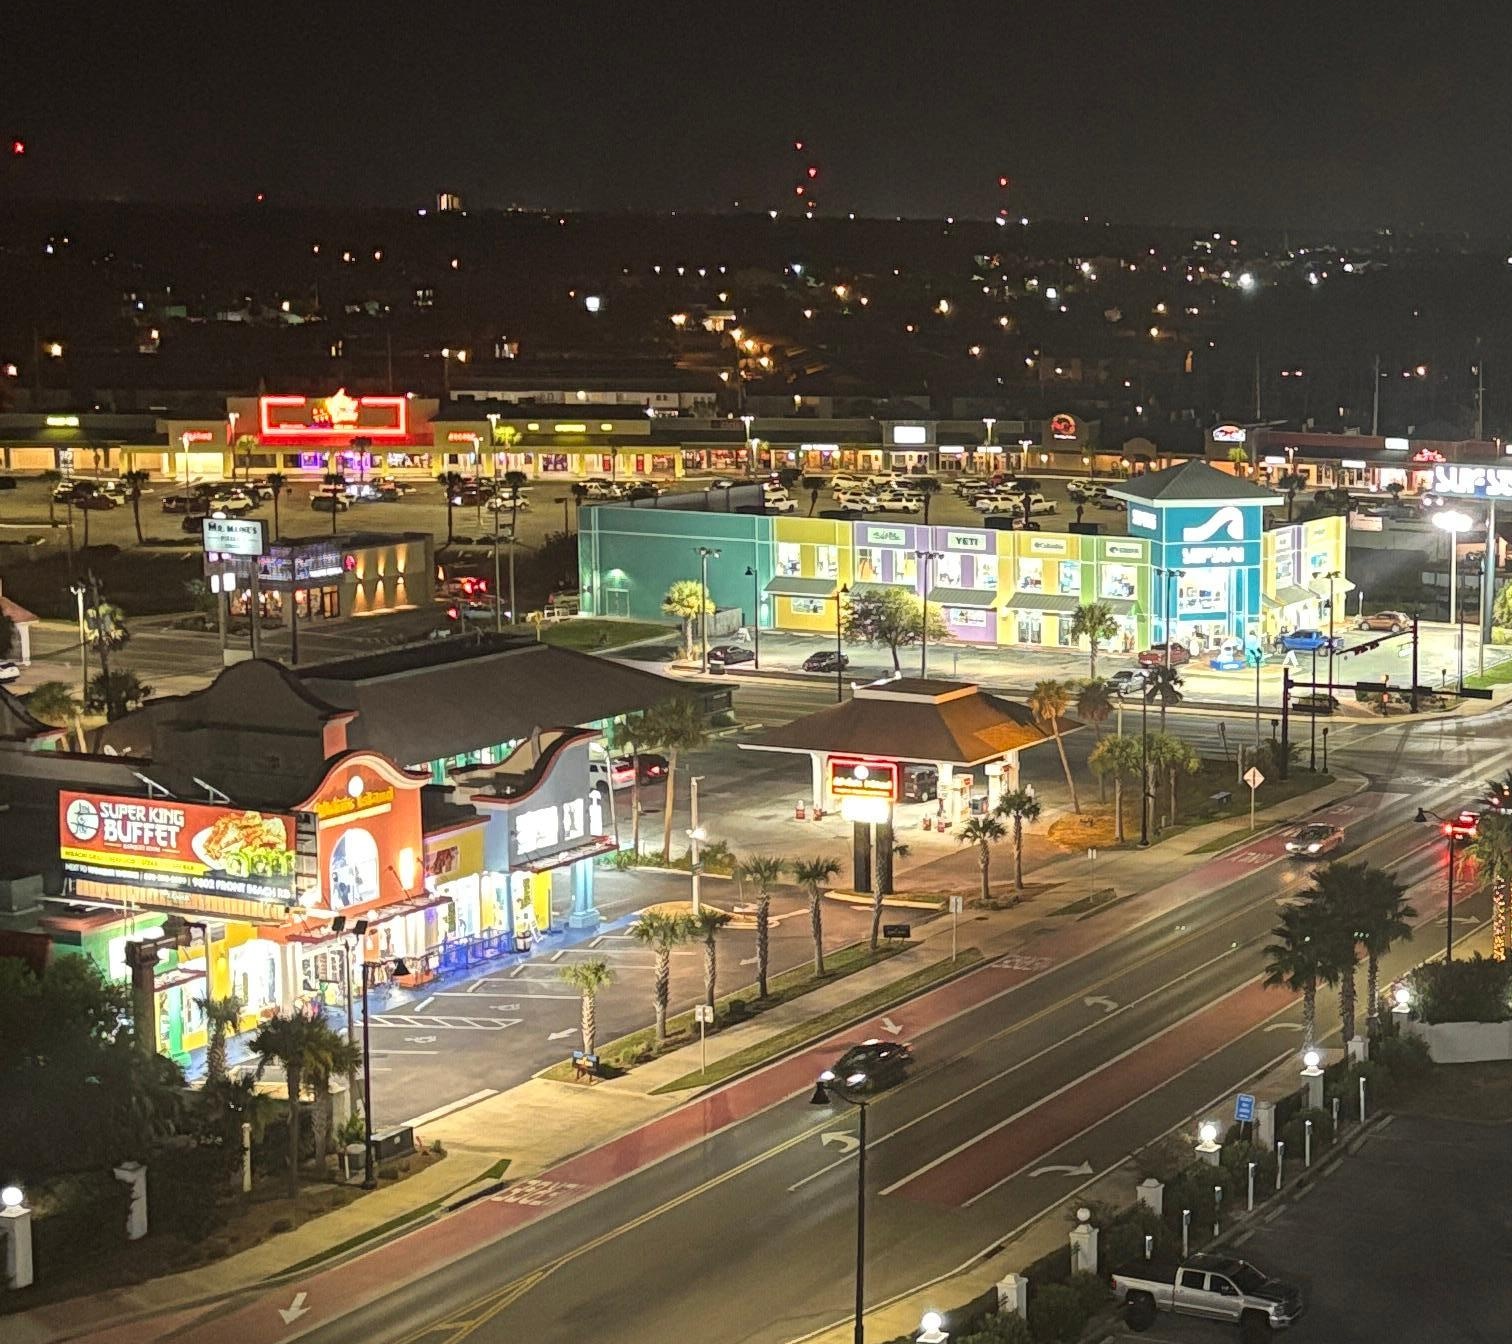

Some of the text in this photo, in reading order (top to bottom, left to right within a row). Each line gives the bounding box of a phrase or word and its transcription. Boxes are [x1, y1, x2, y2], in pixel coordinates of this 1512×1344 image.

[955, 537, 978, 546] YETI
[99, 801, 147, 822] SUPER
[149, 806, 185, 828] KING
[103, 818, 181, 850] BUFFET
